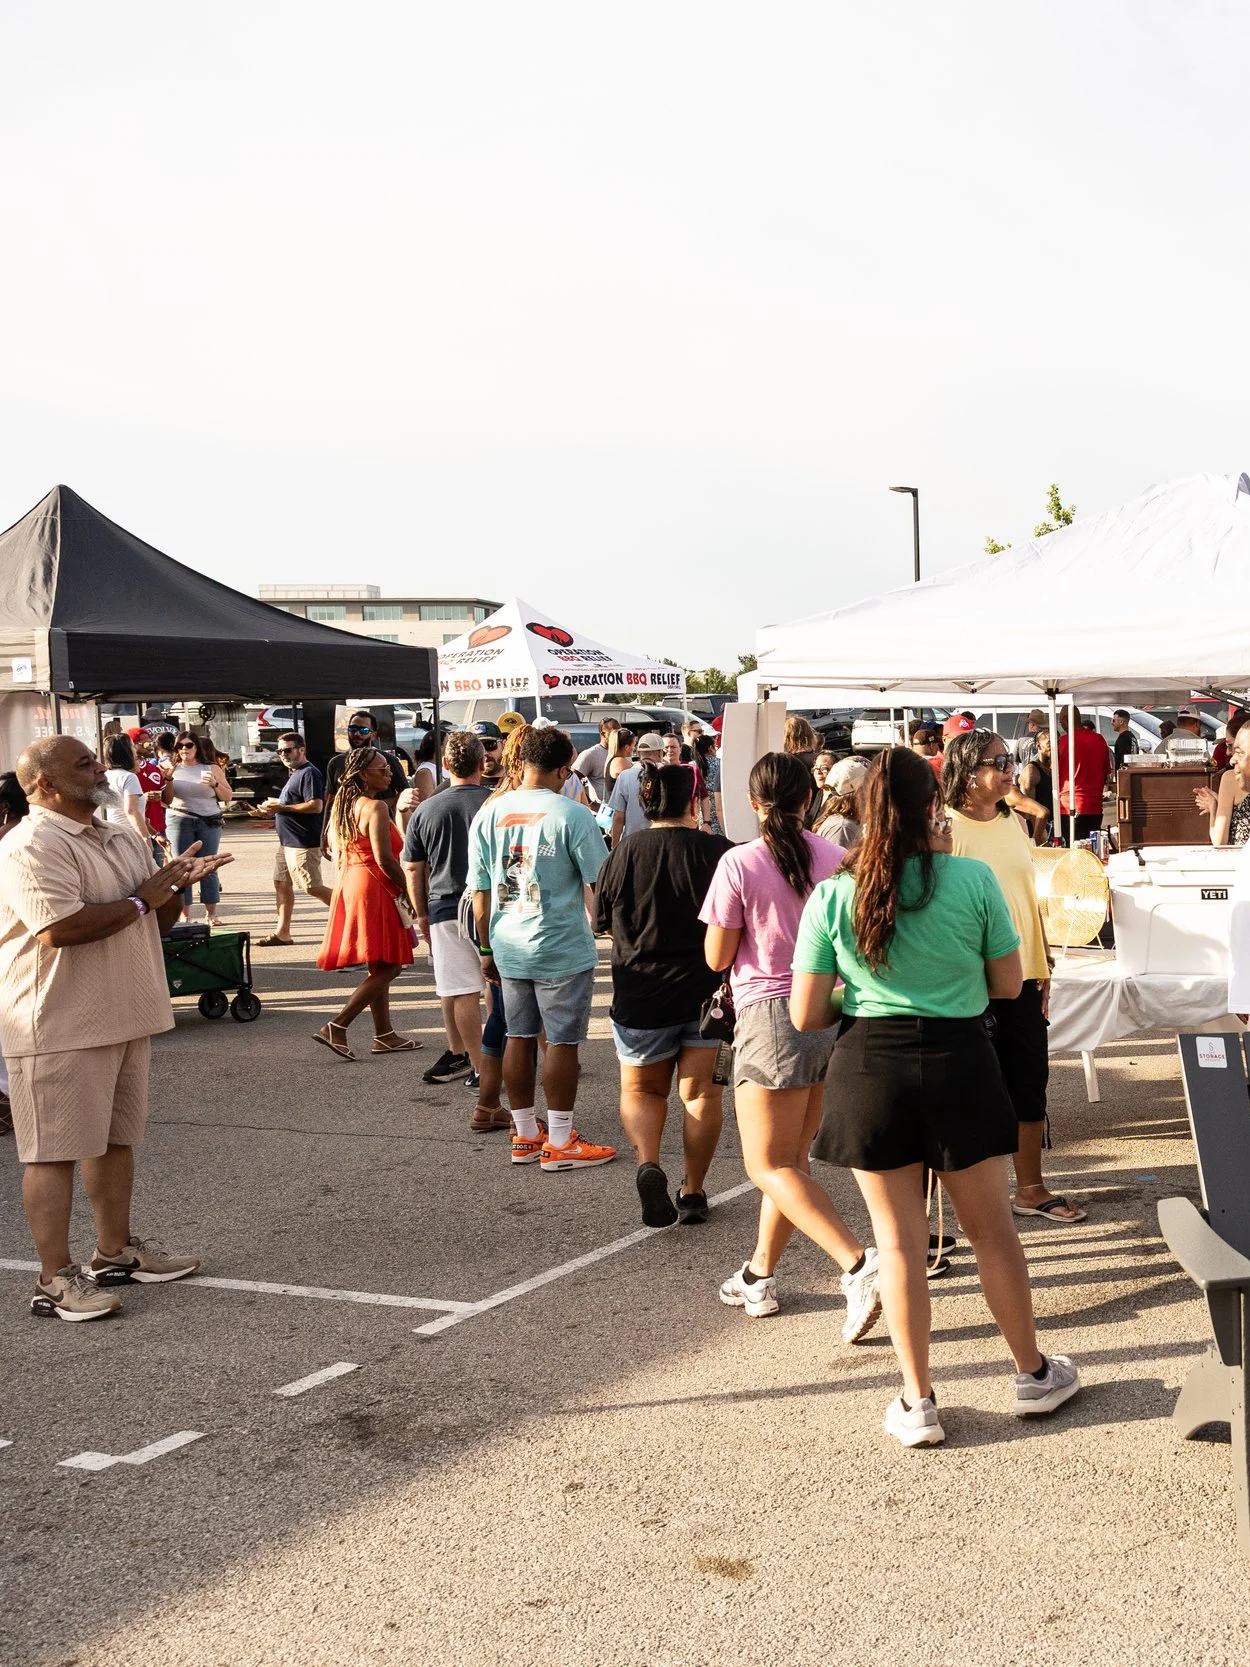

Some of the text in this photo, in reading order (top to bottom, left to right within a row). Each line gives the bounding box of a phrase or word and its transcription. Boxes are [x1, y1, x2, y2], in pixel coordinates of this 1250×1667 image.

[547, 648, 605, 656] OPERATION
[487, 677, 530, 689] RELIEF
[562, 672, 681, 687] OPERATION BBQ RELIEF
[1202, 890, 1227, 899] YETI
